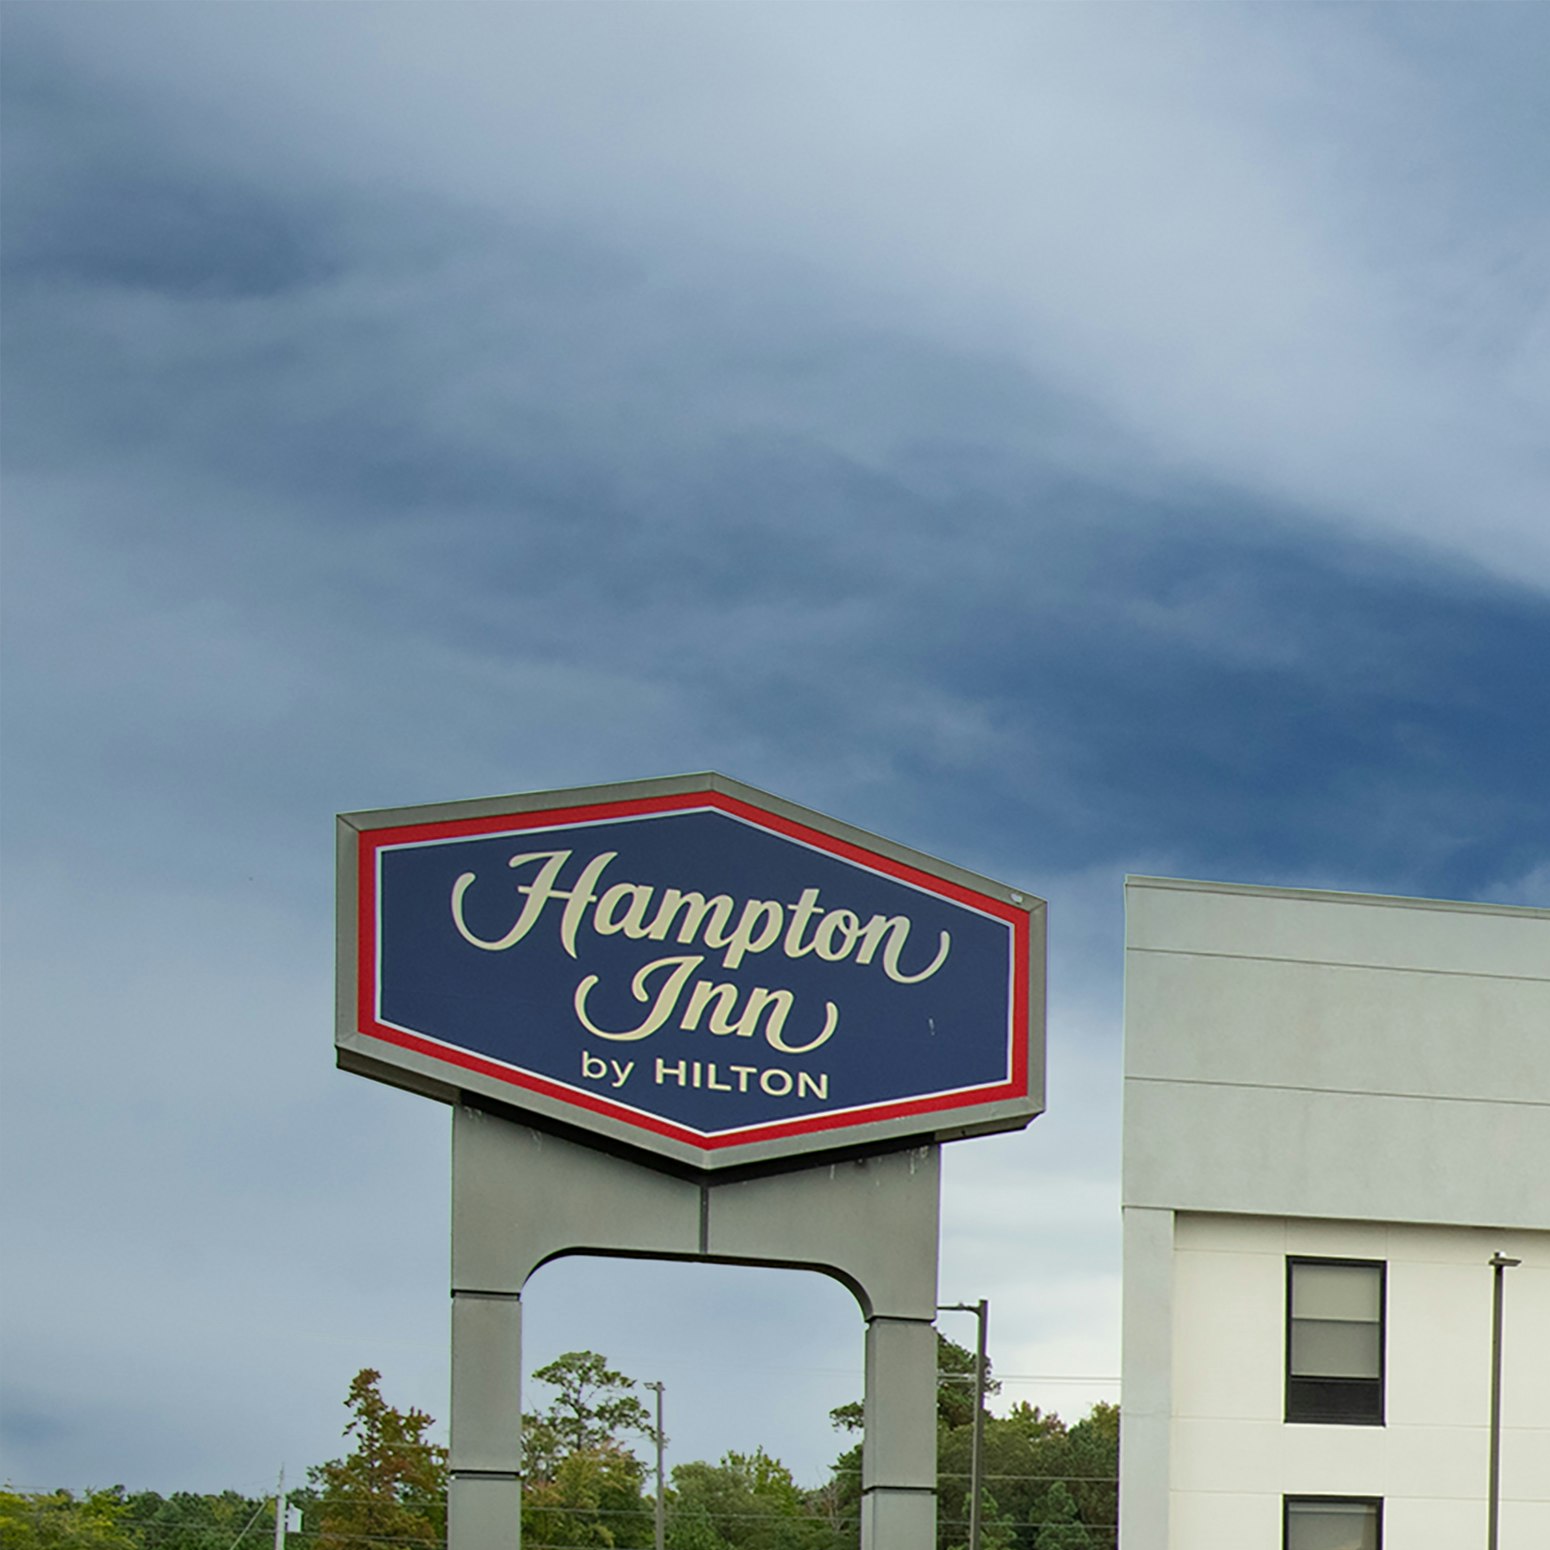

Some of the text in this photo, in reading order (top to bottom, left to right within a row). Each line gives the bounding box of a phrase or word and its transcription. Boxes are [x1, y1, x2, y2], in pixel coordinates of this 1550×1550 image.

[450, 850, 951, 984] Hampton
[574, 955, 838, 1053] Inn
[581, 1050, 828, 1100] by HILTON
